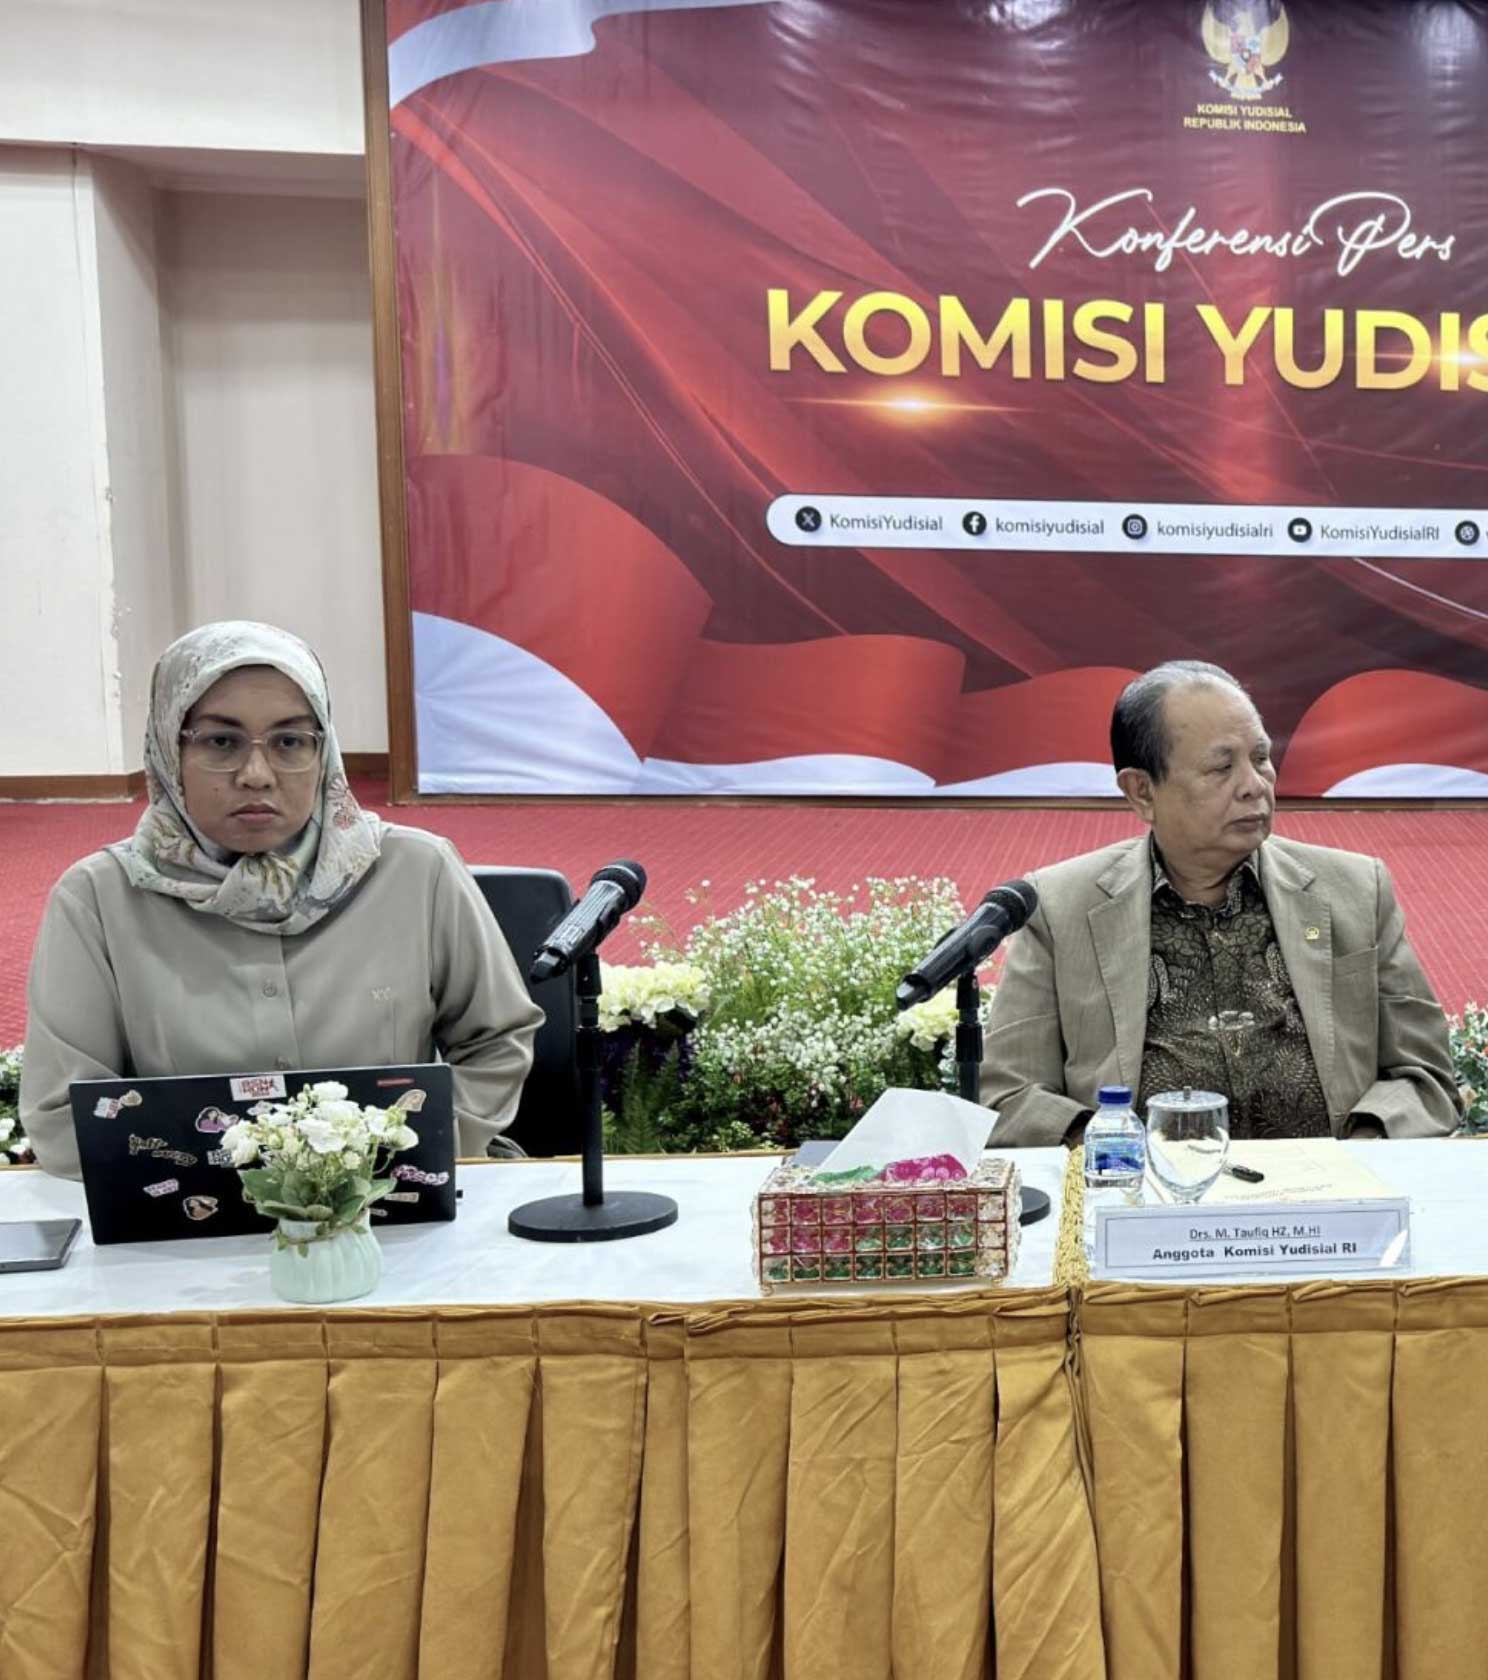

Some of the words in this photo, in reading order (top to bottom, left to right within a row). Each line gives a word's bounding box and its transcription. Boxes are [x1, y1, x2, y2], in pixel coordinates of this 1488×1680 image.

[1197, 103, 1238, 116] KOMISI
[1240, 105, 1293, 119] YUDISIAL
[1183, 117, 1242, 130] REPUBLIK
[1243, 119, 1307, 133] INDONESIA
[1016, 187, 1314, 273] Konferensi
[1308, 191, 1457, 277] Pers
[766, 287, 1167, 384] KOMISI
[829, 512, 944, 532] KomisiYudisial
[995, 516, 1106, 537] komisiyudisial
[1156, 519, 1275, 540] komisiyudisialri
[1319, 524, 1440, 543] KomisiYudisialRI
[1189, 1228, 1211, 1240] Drs.
[1233, 1226, 1269, 1240] Taufiq
[1152, 1247, 1215, 1262] Anggota
[1224, 1244, 1275, 1258] Komisi
[1279, 1242, 1337, 1256] Yudisial
[1342, 1241, 1358, 1254] RI
